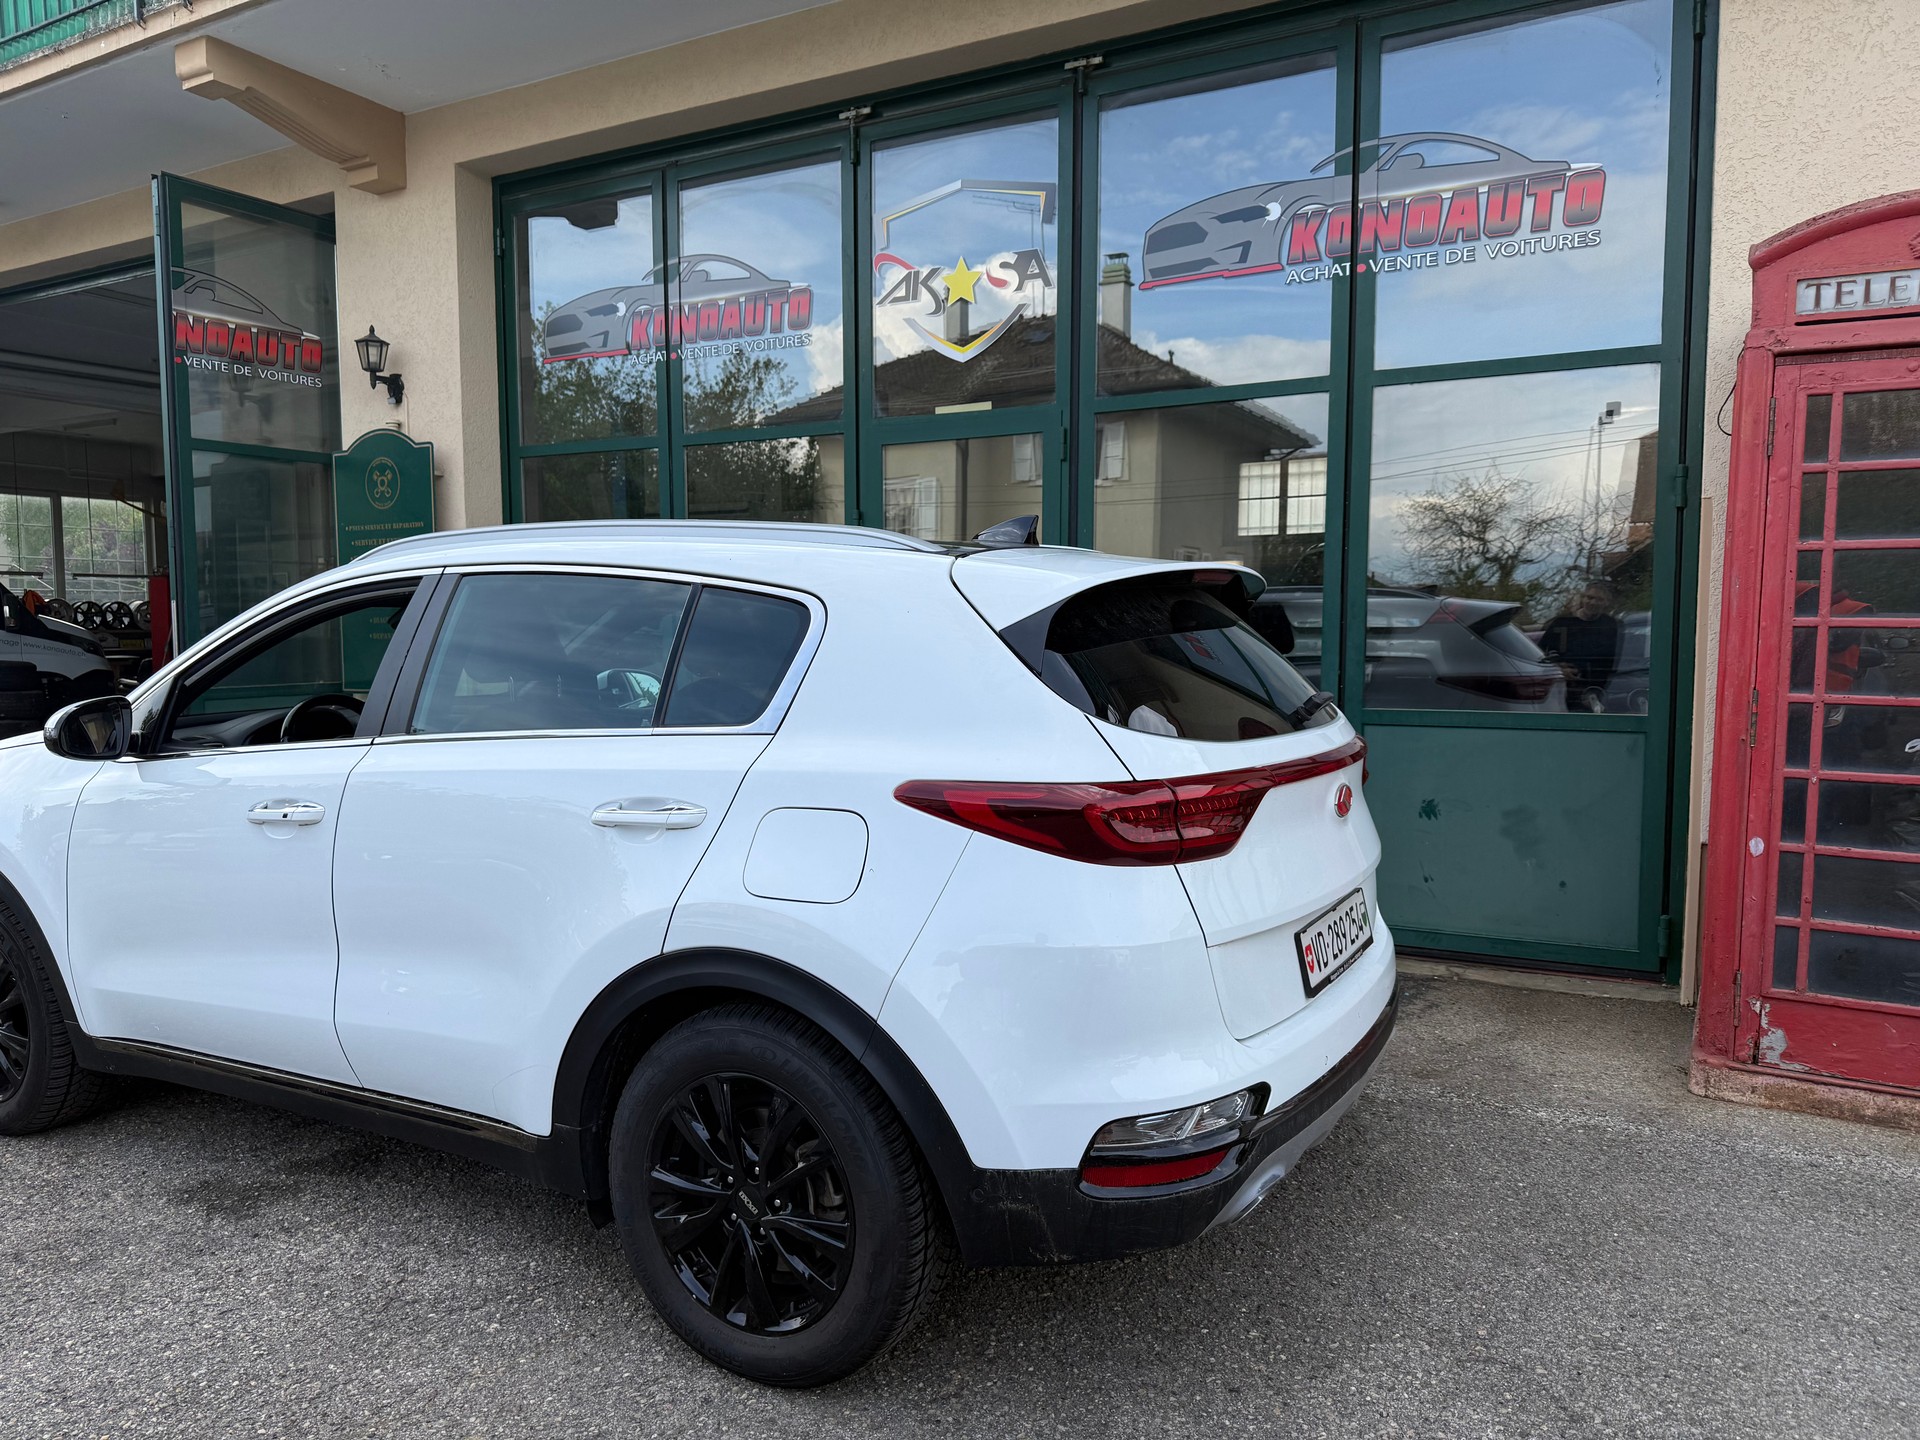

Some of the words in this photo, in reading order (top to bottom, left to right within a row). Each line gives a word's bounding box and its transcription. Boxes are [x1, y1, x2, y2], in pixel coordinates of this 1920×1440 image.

[1287, 168, 1606, 264] KONOAUTO
[1285, 262, 1351, 285] ACHAT
[1369, 249, 1439, 274] VENTE
[1444, 246, 1476, 265] DE
[1485, 230, 1601, 259] VOITURES
[630, 286, 813, 350] KONOAUTO
[1805, 272, 1920, 311] TELE
[173, 311, 323, 374] NOAUTO
[630, 350, 667, 366] ACHAT
[678, 345, 719, 360] VENTE
[722, 343, 740, 355] DE
[744, 333, 812, 352] VOITURES
[183, 355, 229, 373] VENTE
[233, 364, 253, 377] DE
[258, 368, 323, 388] VOITURES
